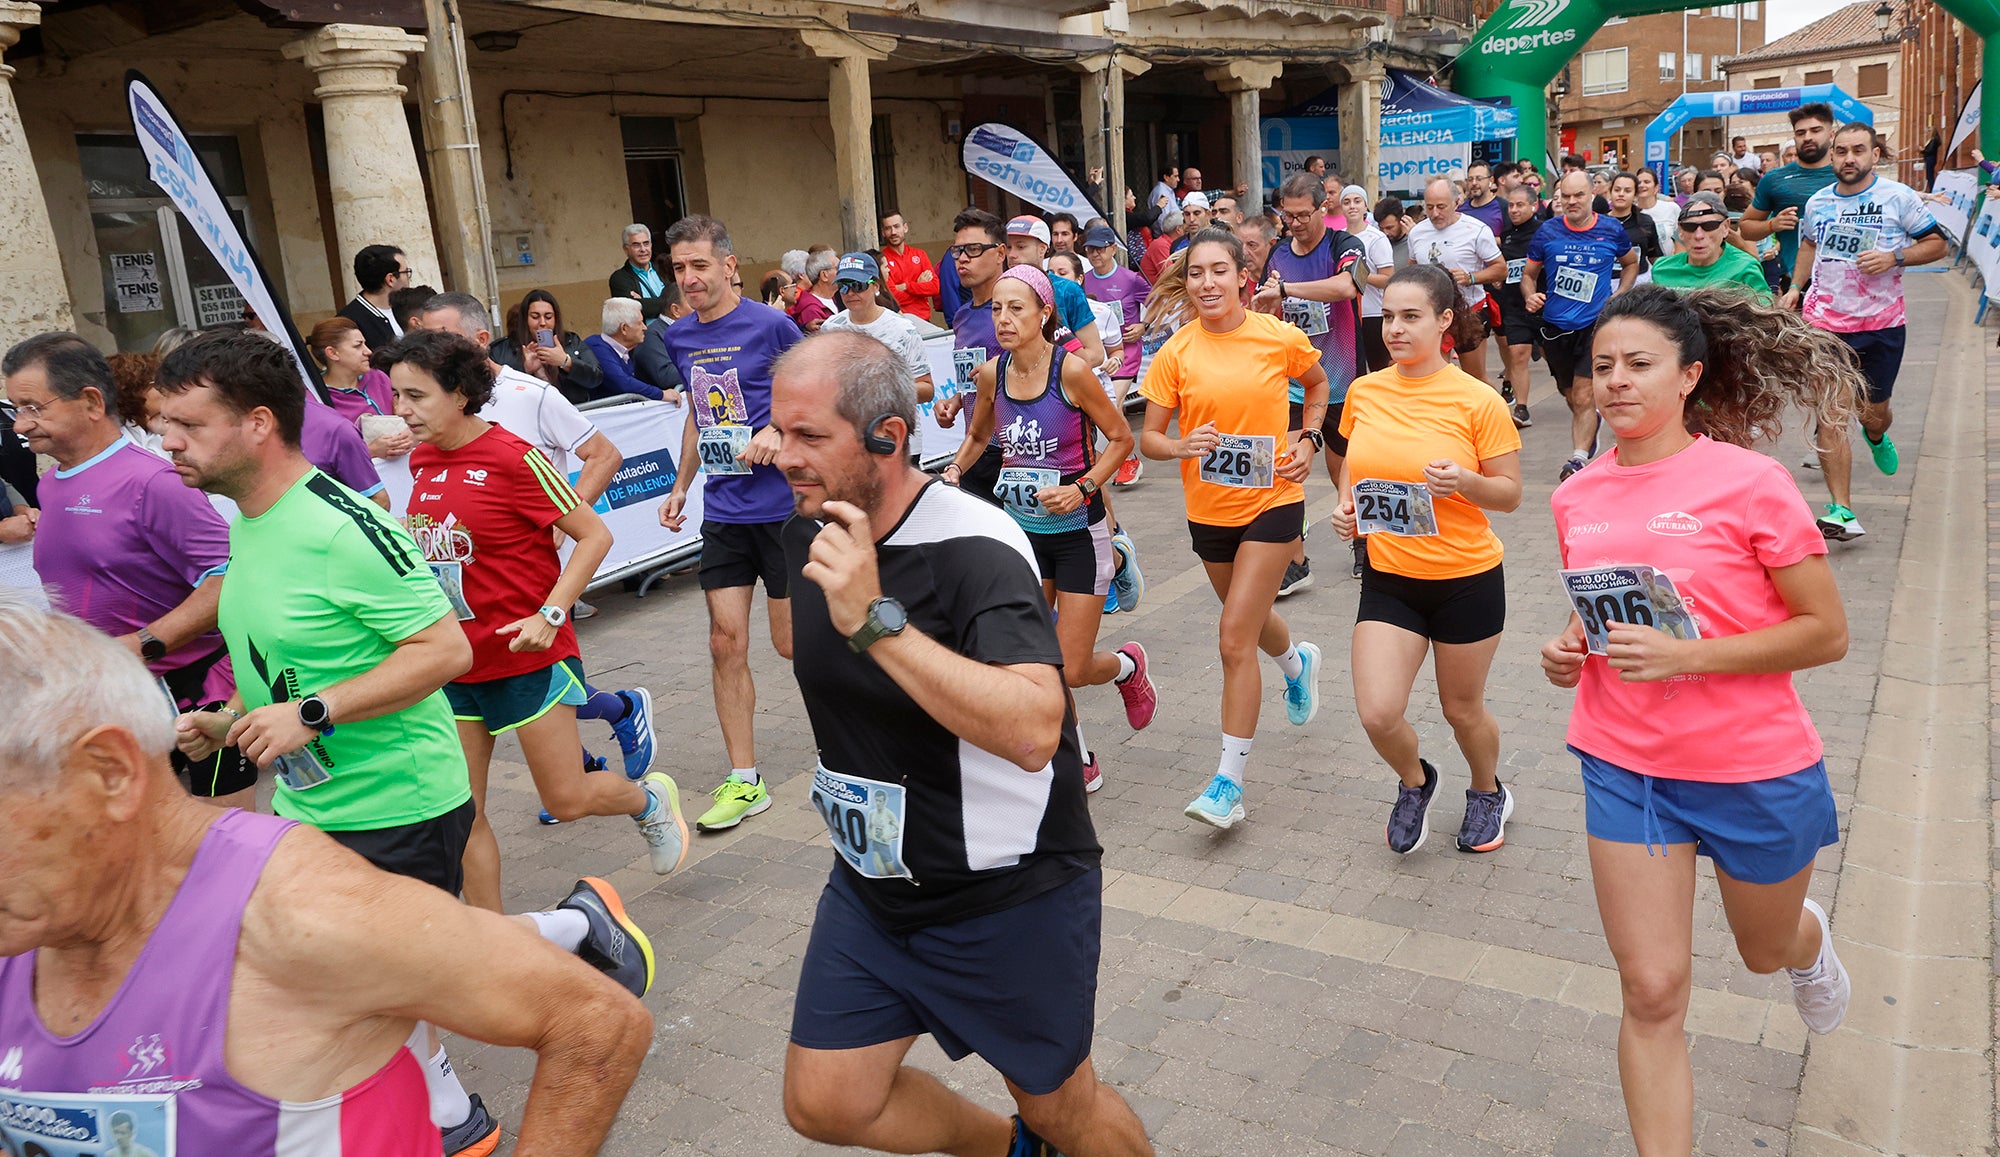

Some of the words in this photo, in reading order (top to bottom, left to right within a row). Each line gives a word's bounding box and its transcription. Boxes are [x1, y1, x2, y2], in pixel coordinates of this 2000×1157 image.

[1481, 29, 1576, 55] deportes
[1742, 102, 1755, 111] DE
[1756, 99, 1800, 110] PALENCIA
[1743, 92, 1790, 102] Diputación
[1379, 128, 1454, 146] ALENCIA
[1378, 156, 1463, 181] eportes
[1839, 216, 1884, 224] CARRERA
[1825, 234, 1861, 254] 458
[116, 254, 154, 267] TENIS
[118, 282, 159, 296] TENIS
[1557, 275, 1583, 294] 200
[200, 288, 214, 301] SE
[201, 302, 219, 313] 655
[221, 300, 235, 311] 419
[205, 312, 220, 324] 671
[221, 311, 236, 321] 070
[701, 441, 734, 465] 298
[1203, 450, 1252, 477] 226
[609, 487, 626, 502] DE
[626, 472, 677, 497] PALENCIA
[997, 483, 1040, 509] 213
[1358, 494, 1411, 525] 254
[1568, 521, 1610, 538] OYSHO
[1650, 519, 1698, 531] ASTURIANA
[1580, 572, 1617, 585] 10.000
[1609, 578, 1636, 588] HARO
[1576, 590, 1654, 635] 306
[284, 667, 303, 700] STILLA
